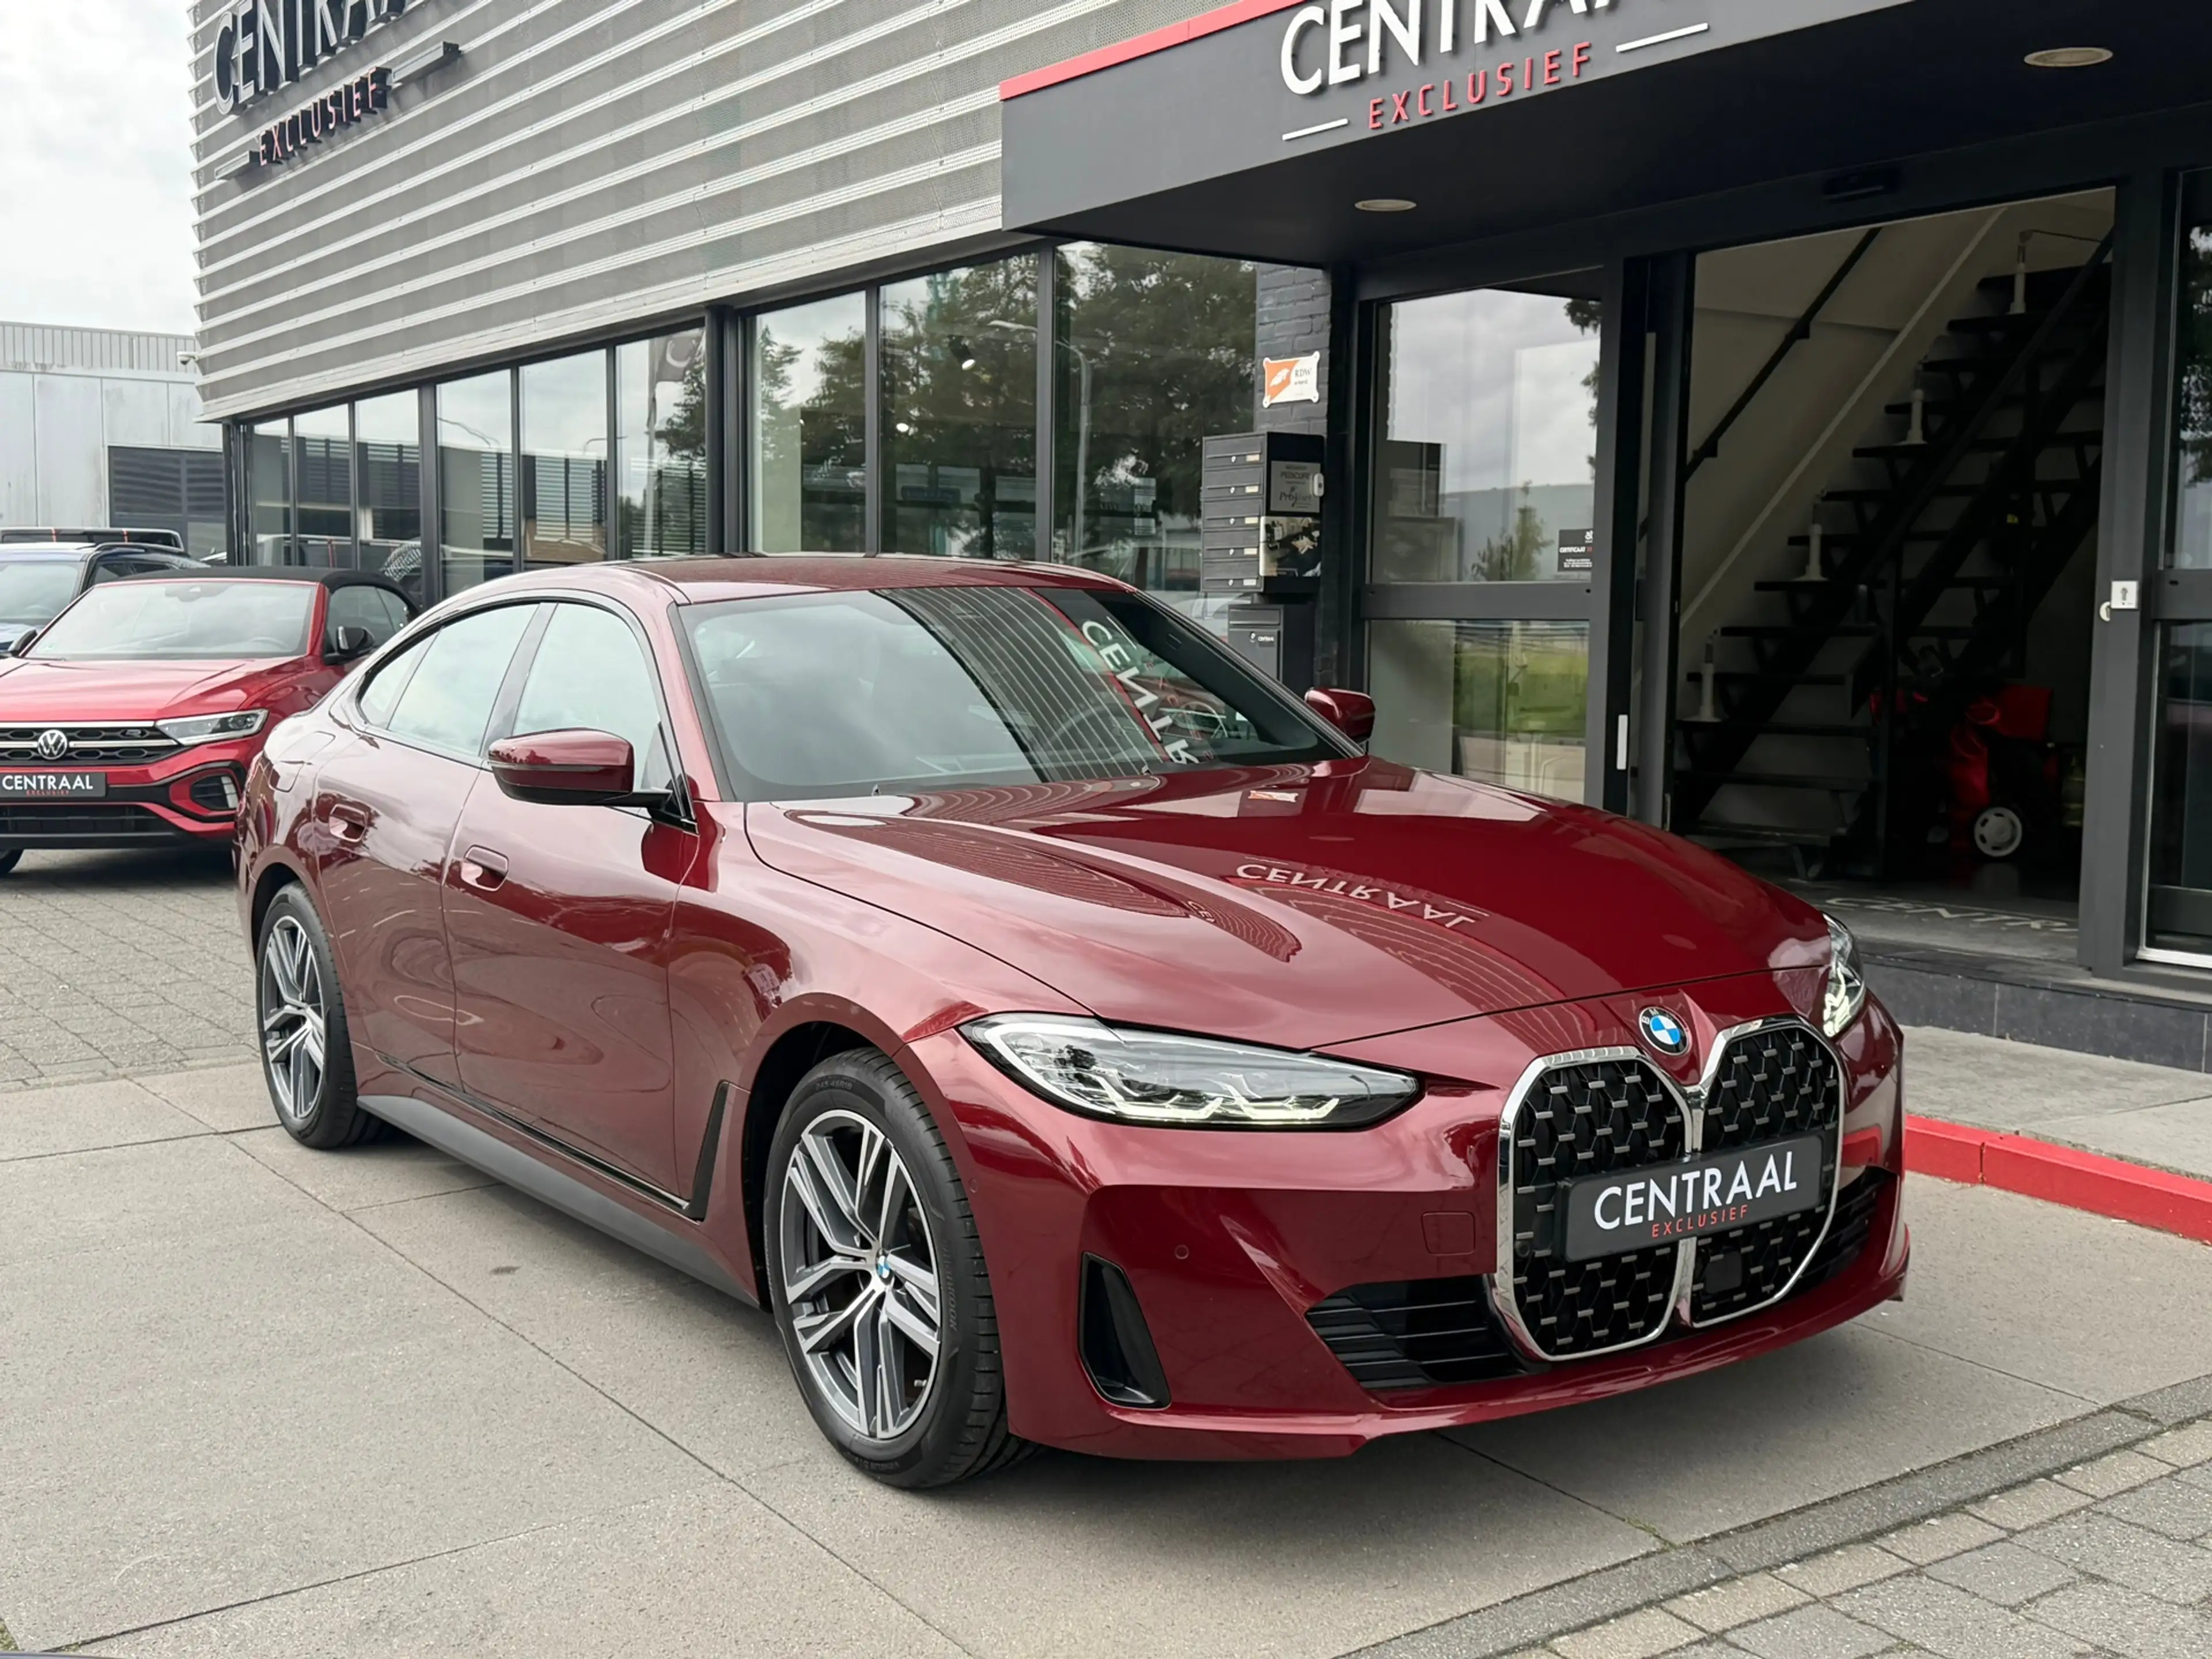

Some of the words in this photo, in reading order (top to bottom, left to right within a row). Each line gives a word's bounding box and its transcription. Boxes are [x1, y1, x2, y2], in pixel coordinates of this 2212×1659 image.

[259, 66, 385, 166] EXCLUSIEF
[1368, 41, 1592, 130] EXCLUSIEF
[2, 775, 93, 790] CENTRAAL
[1594, 1151, 1797, 1230] CENTRAAL
[1652, 1205, 1748, 1238] EXCLUSIEF
